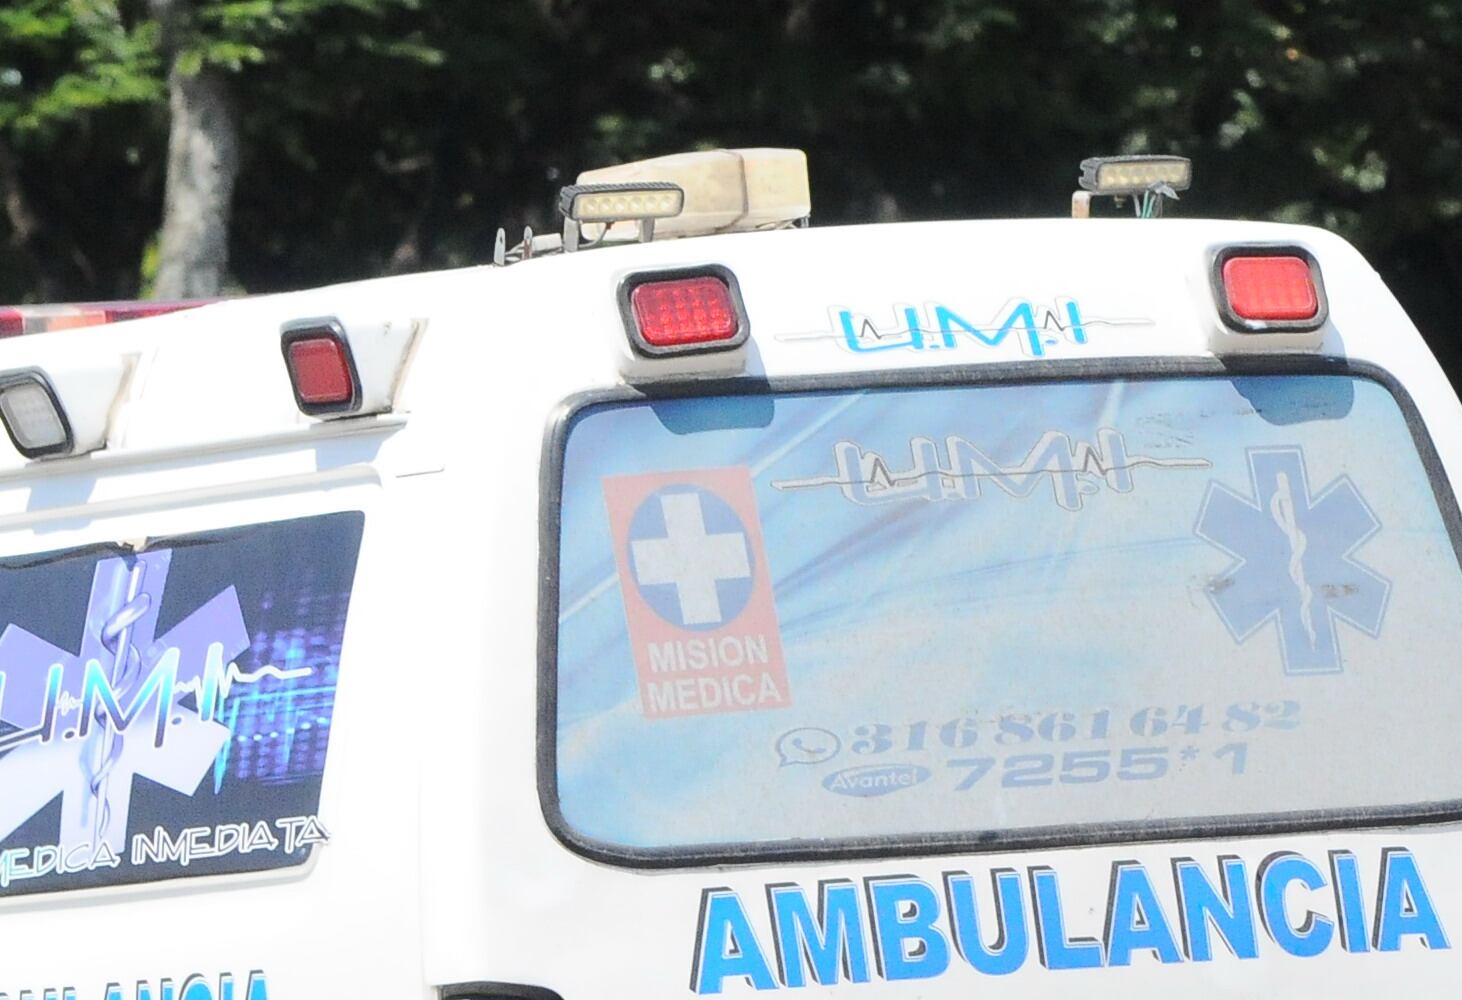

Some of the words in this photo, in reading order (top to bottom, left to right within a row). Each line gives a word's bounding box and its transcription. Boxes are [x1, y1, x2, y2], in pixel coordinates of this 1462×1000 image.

[647, 634, 769, 672] MISION
[647, 675, 783, 712] MEDICA
[850, 716, 976, 755] 316
[994, 709, 1110, 745] 861
[1129, 704, 1210, 738] 64
[830, 767, 918, 791] Avantel
[689, 847, 1452, 996] AMBULANCIA
